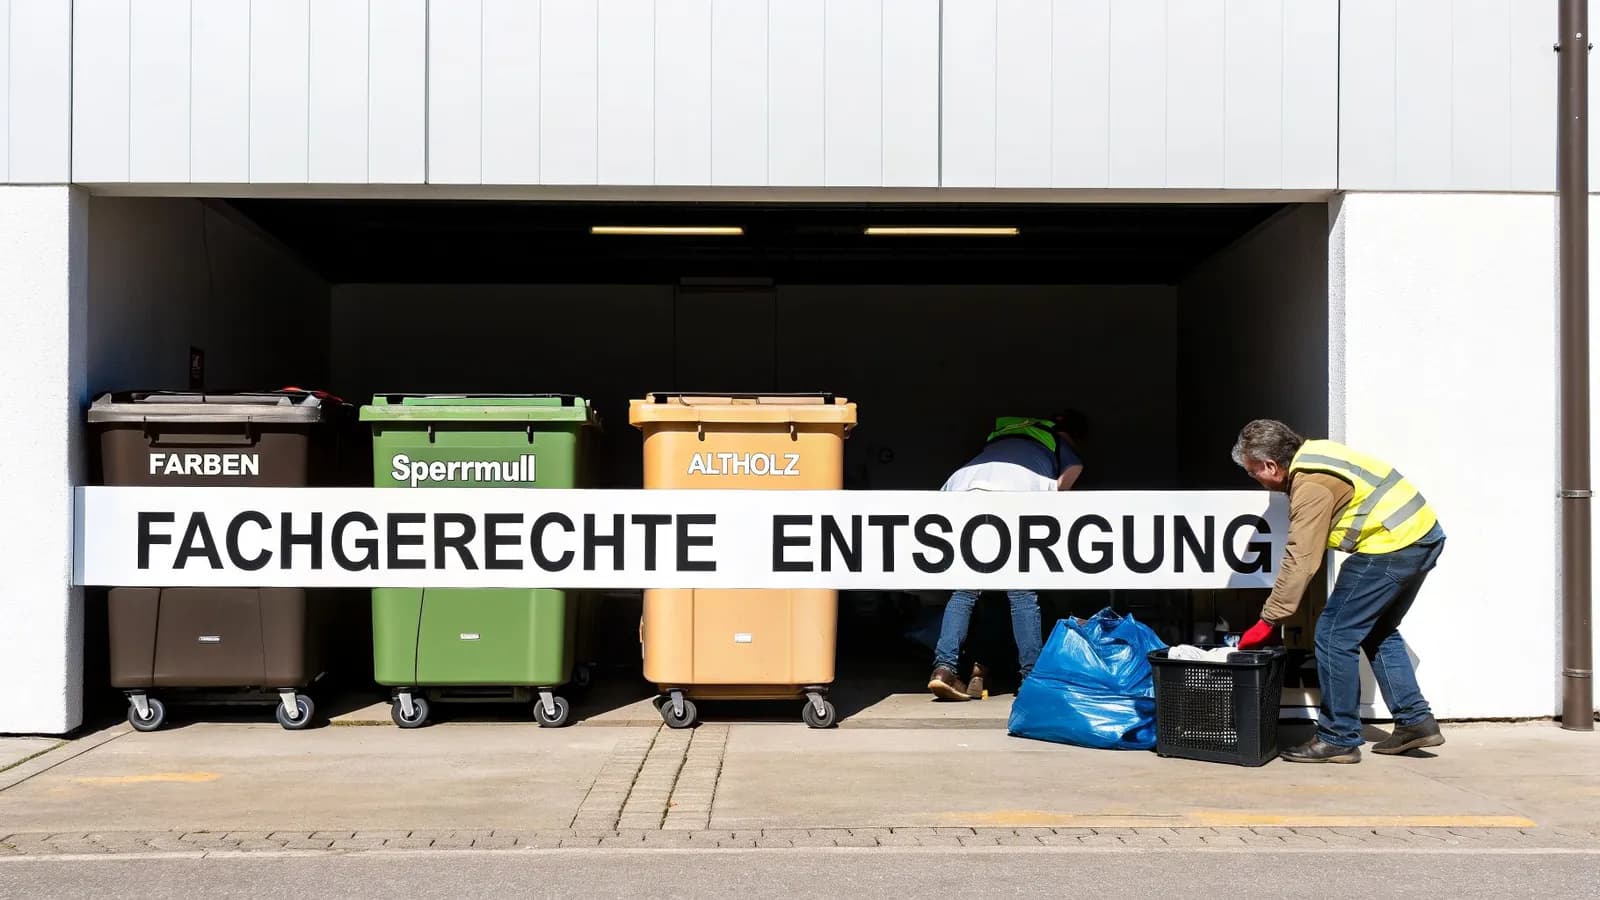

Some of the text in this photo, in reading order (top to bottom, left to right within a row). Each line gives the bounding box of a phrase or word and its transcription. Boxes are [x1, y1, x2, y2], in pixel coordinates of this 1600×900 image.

[149, 453, 260, 476] FARBEN
[391, 453, 536, 488] Sperrmull
[687, 452, 800, 476] ALTHOLZ
[137, 510, 1272, 574] FACHGERECHTE ENTSORGUNG
